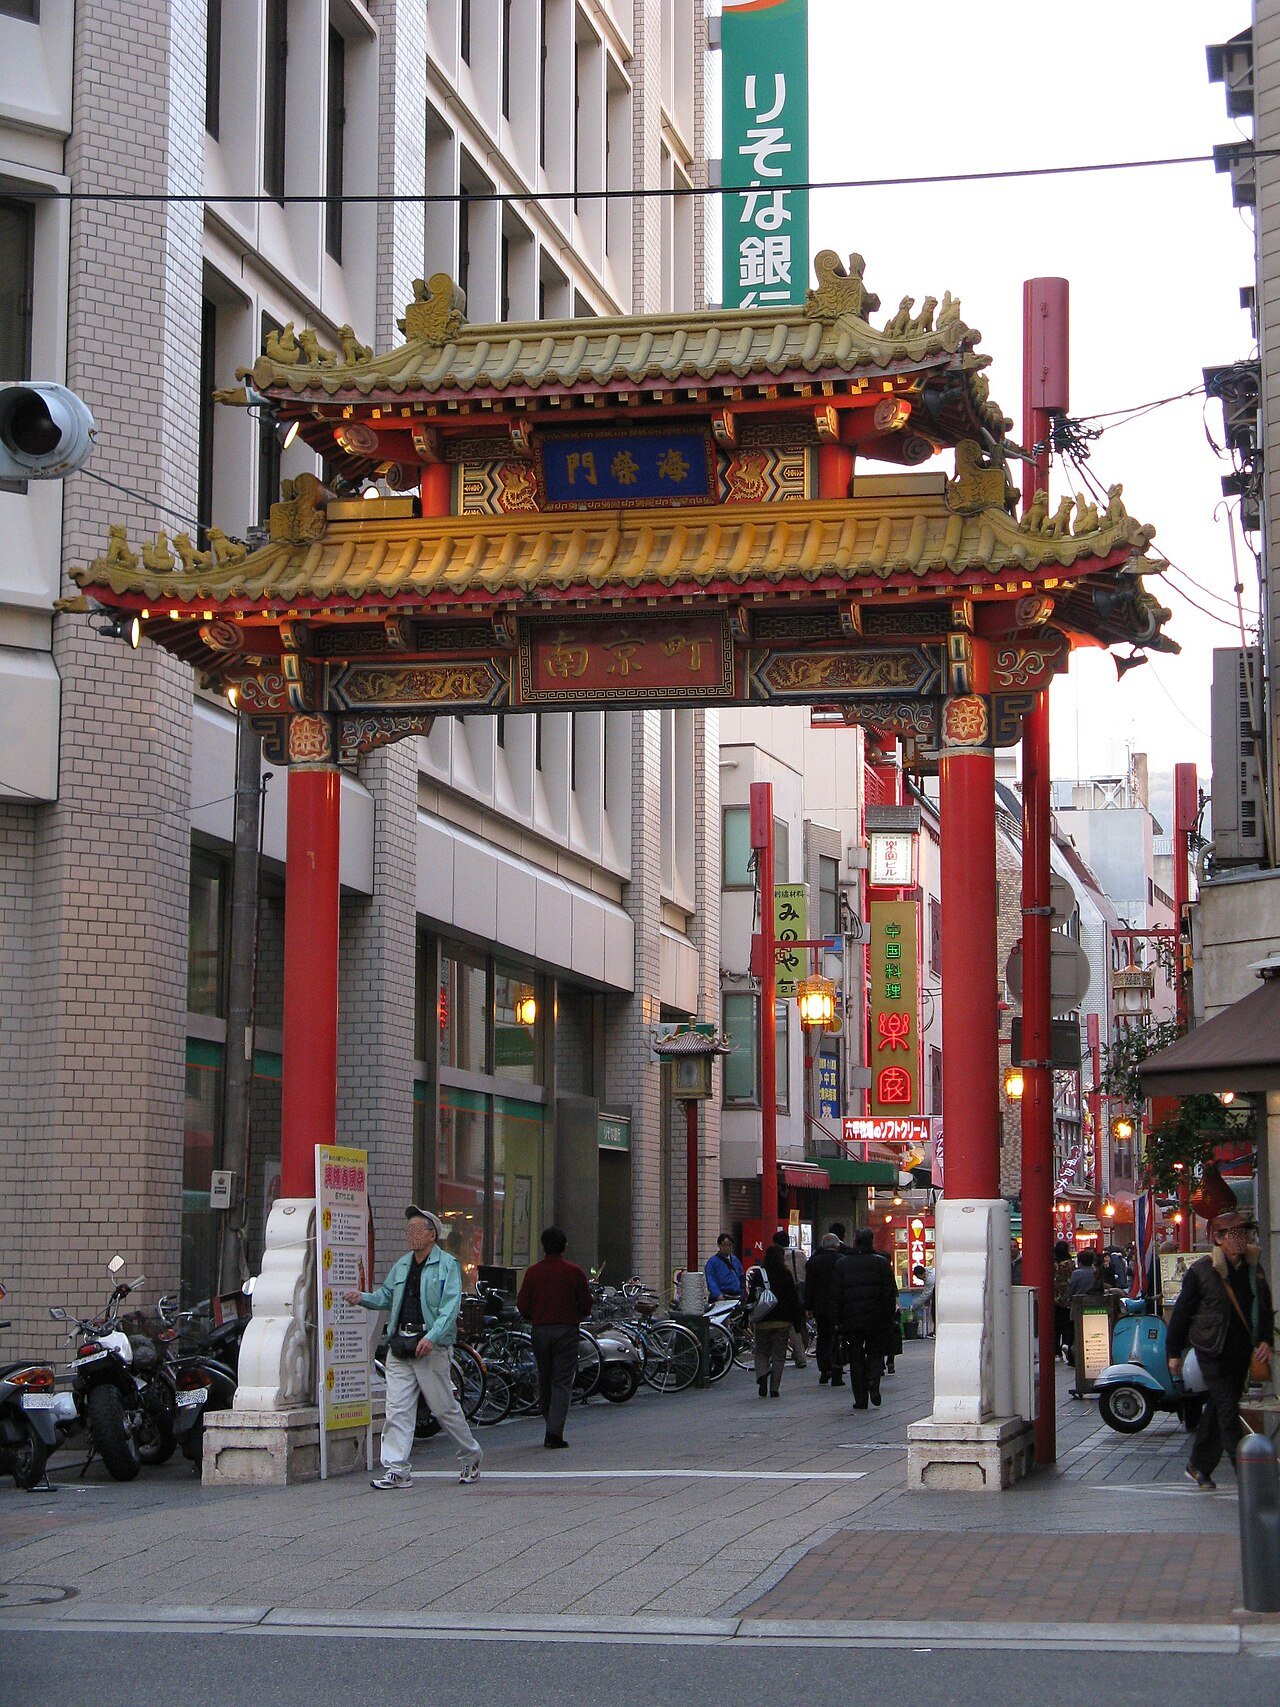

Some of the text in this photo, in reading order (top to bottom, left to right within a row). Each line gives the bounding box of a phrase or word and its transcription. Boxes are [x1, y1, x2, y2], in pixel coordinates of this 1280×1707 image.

[544, 630, 713, 678] 南京町
[885, 922, 901, 999] 中国料理
